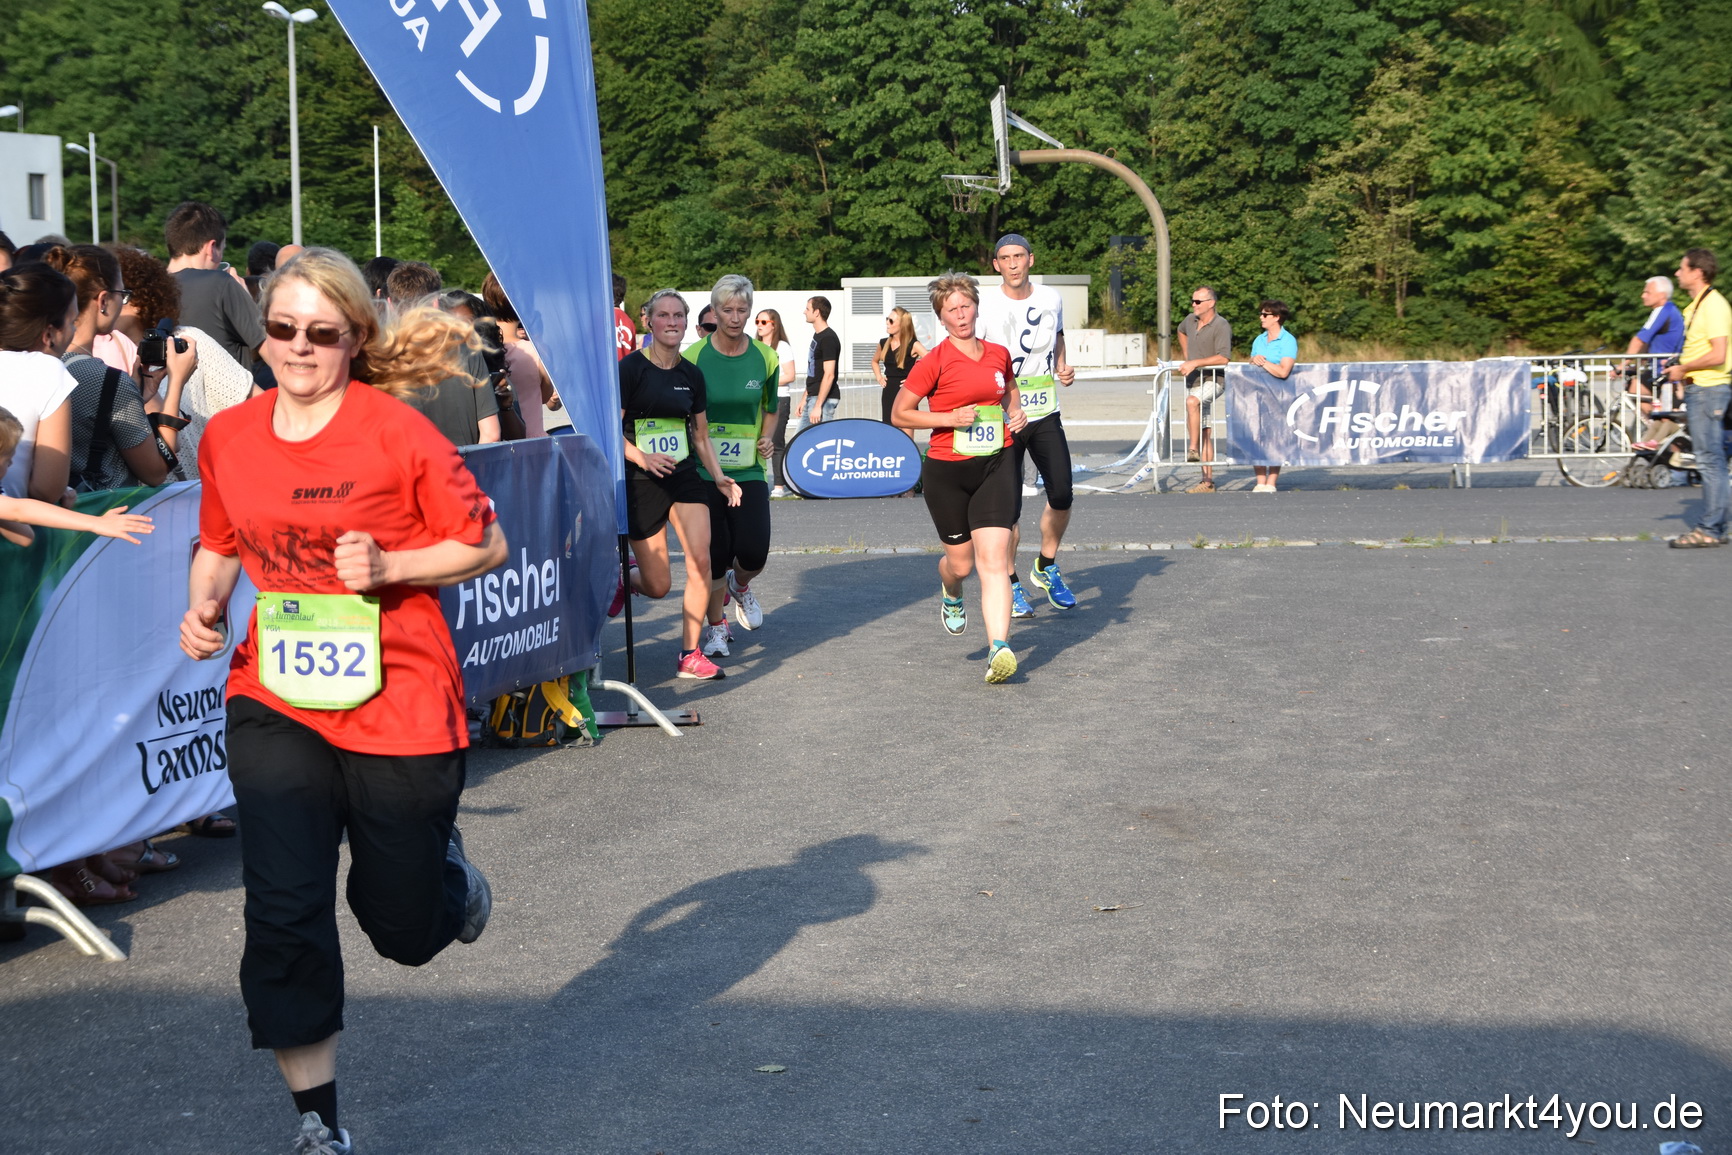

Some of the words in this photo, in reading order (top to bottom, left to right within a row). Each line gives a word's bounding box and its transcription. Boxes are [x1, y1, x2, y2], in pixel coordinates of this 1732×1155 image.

[1020, 392, 1048, 407] 345
[1318, 404, 1467, 434] Fischer
[966, 426, 995, 442] 198
[648, 436, 679, 453] 109
[719, 441, 741, 457] 24
[1332, 435, 1455, 450] AUTOMOBILE
[822, 452, 906, 472] Fischer
[831, 470, 901, 480] AUTOMOBILE
[291, 486, 333, 500] swn
[275, 611, 315, 622] firmenlauf
[462, 616, 560, 669] AUTOMOBILE
[271, 639, 366, 677] 1532
